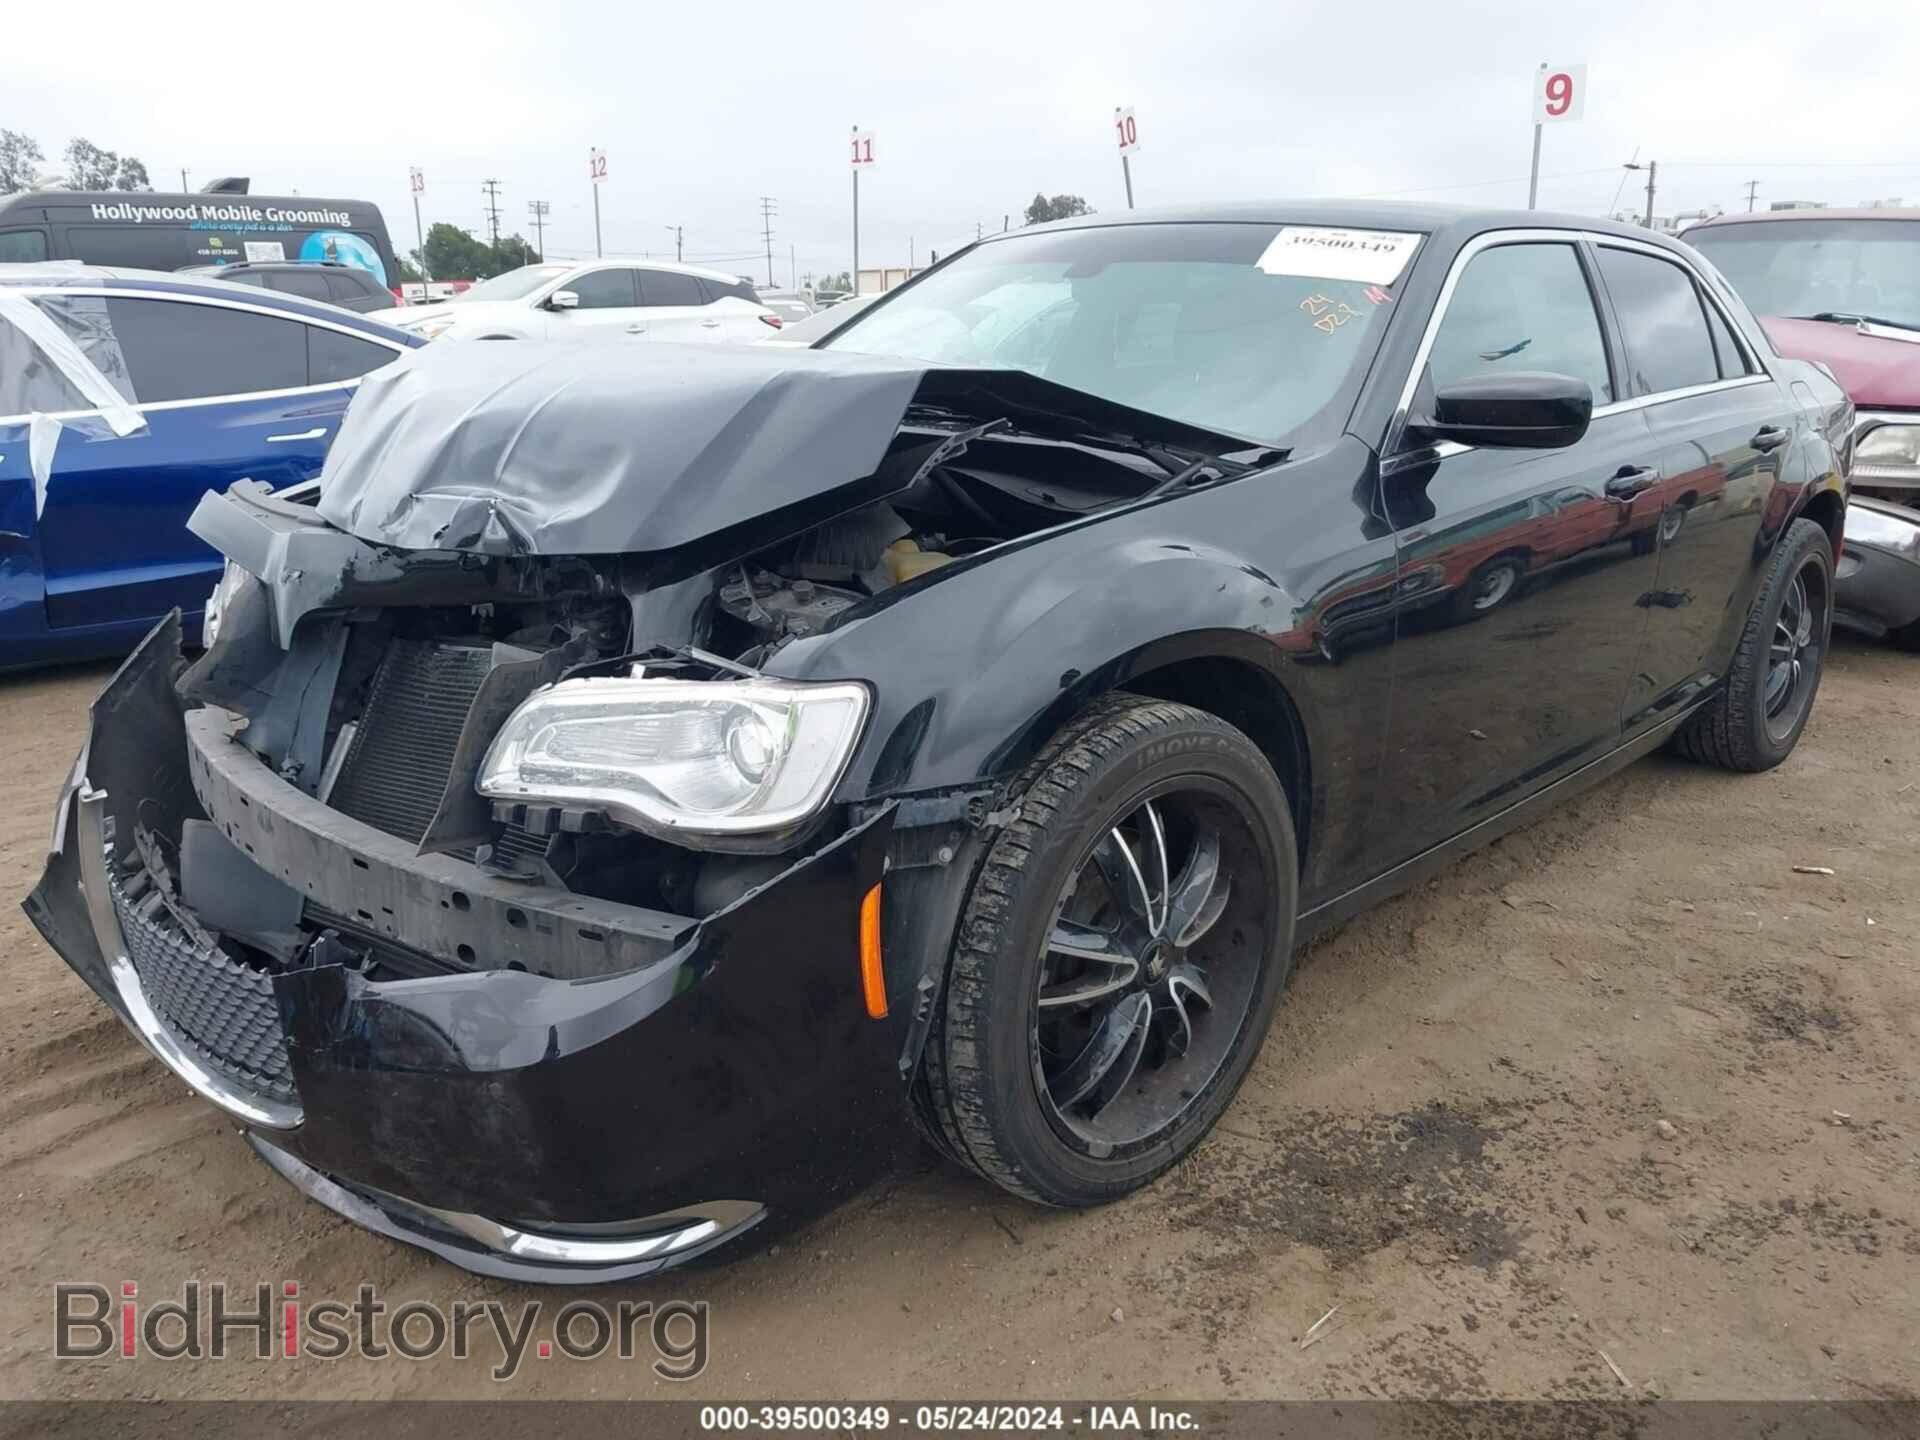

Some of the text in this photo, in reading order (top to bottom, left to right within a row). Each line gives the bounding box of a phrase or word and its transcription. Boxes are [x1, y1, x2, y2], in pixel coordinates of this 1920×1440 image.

[1546, 73, 1573, 116] 9
[1116, 116, 1137, 148] 10
[851, 138, 874, 163] 11
[590, 156, 607, 178] 12
[410, 172, 425, 192] 13
[91, 203, 351, 227] Hollywood Mobile Grooming
